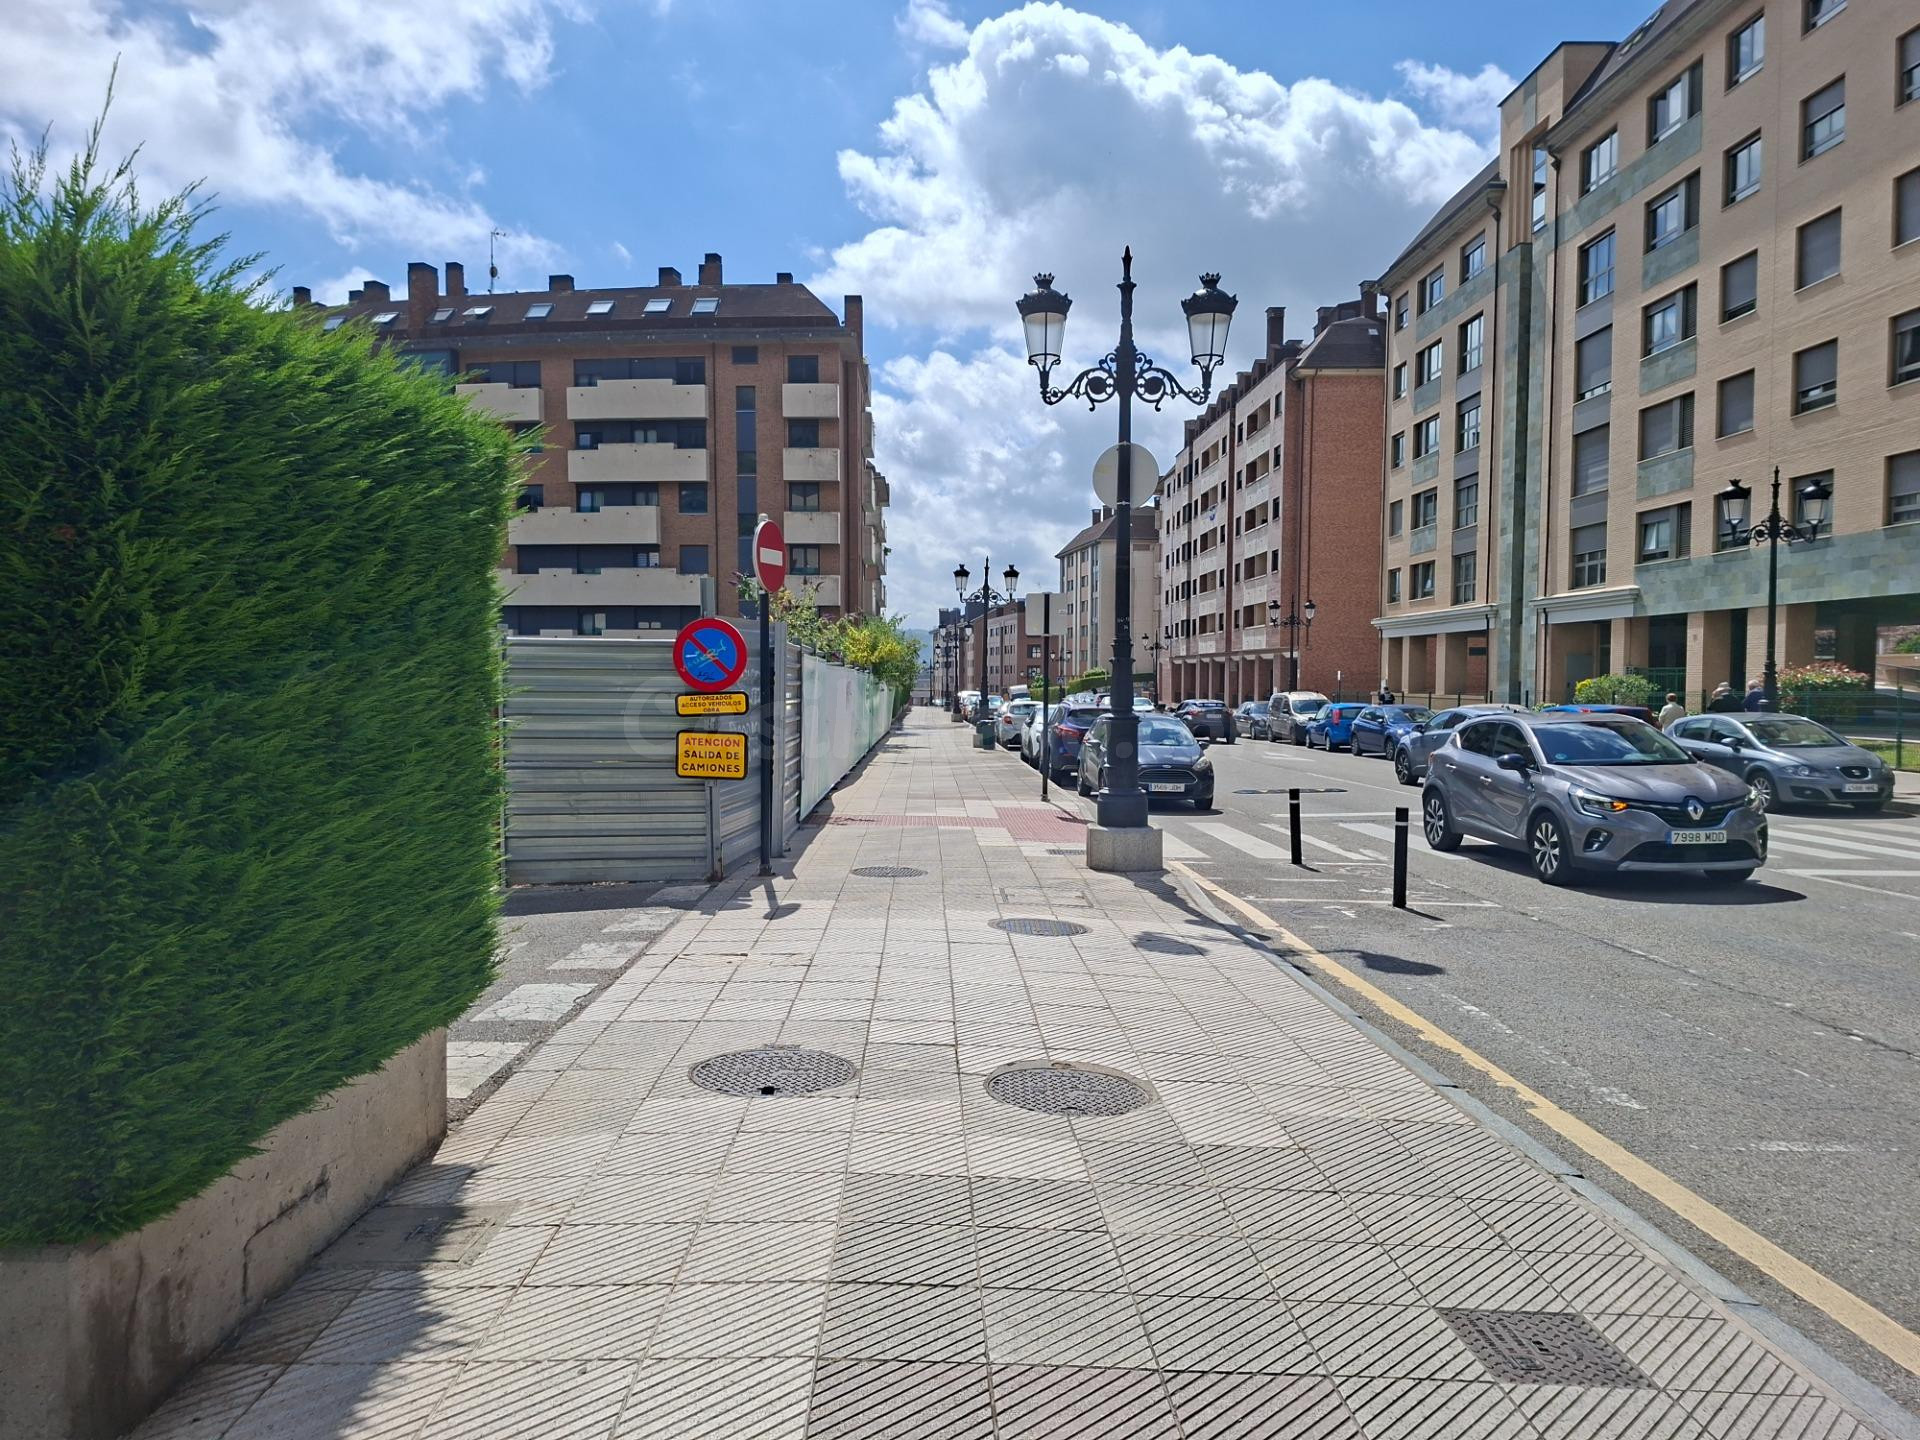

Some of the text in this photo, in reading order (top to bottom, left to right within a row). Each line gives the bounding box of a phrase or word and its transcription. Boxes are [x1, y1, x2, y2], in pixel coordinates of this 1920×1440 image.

[684, 737, 740, 747] ATENCIÓN
[684, 750, 740, 760] SALIDA DE
[681, 763, 740, 773] CAMIONES
[1673, 832, 1701, 843] 7998
